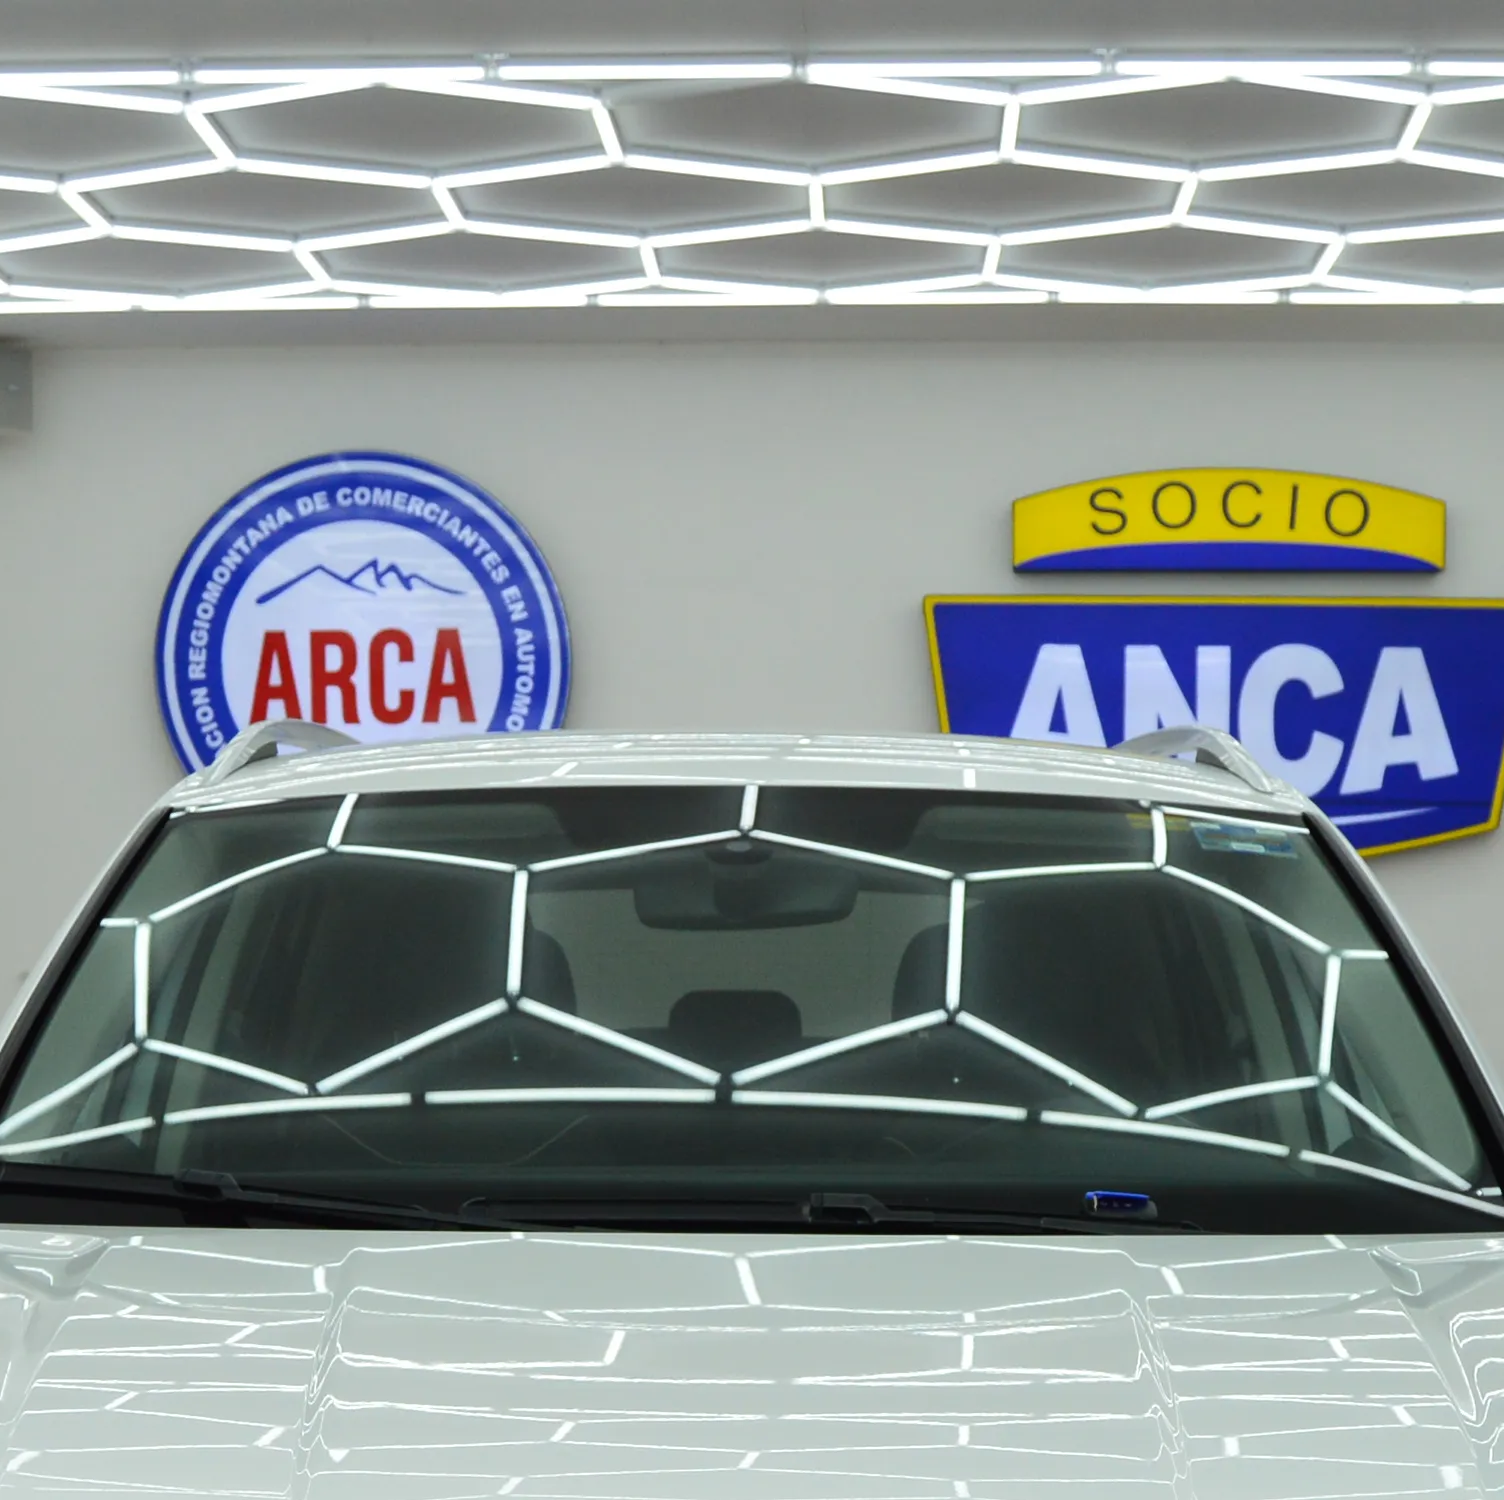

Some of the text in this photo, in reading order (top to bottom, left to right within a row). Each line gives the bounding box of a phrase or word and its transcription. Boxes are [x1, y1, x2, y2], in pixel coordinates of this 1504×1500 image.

[297, 491, 331, 517] DE
[336, 486, 510, 588] COMERCIANTES
[1088, 480, 1371, 538] SOCIO
[187, 506, 294, 681] REGIOMONTANA
[499, 584, 530, 622] EN
[189, 685, 225, 750] CION
[248, 627, 477, 727] ARCA
[1010, 642, 1459, 800] ANCA
